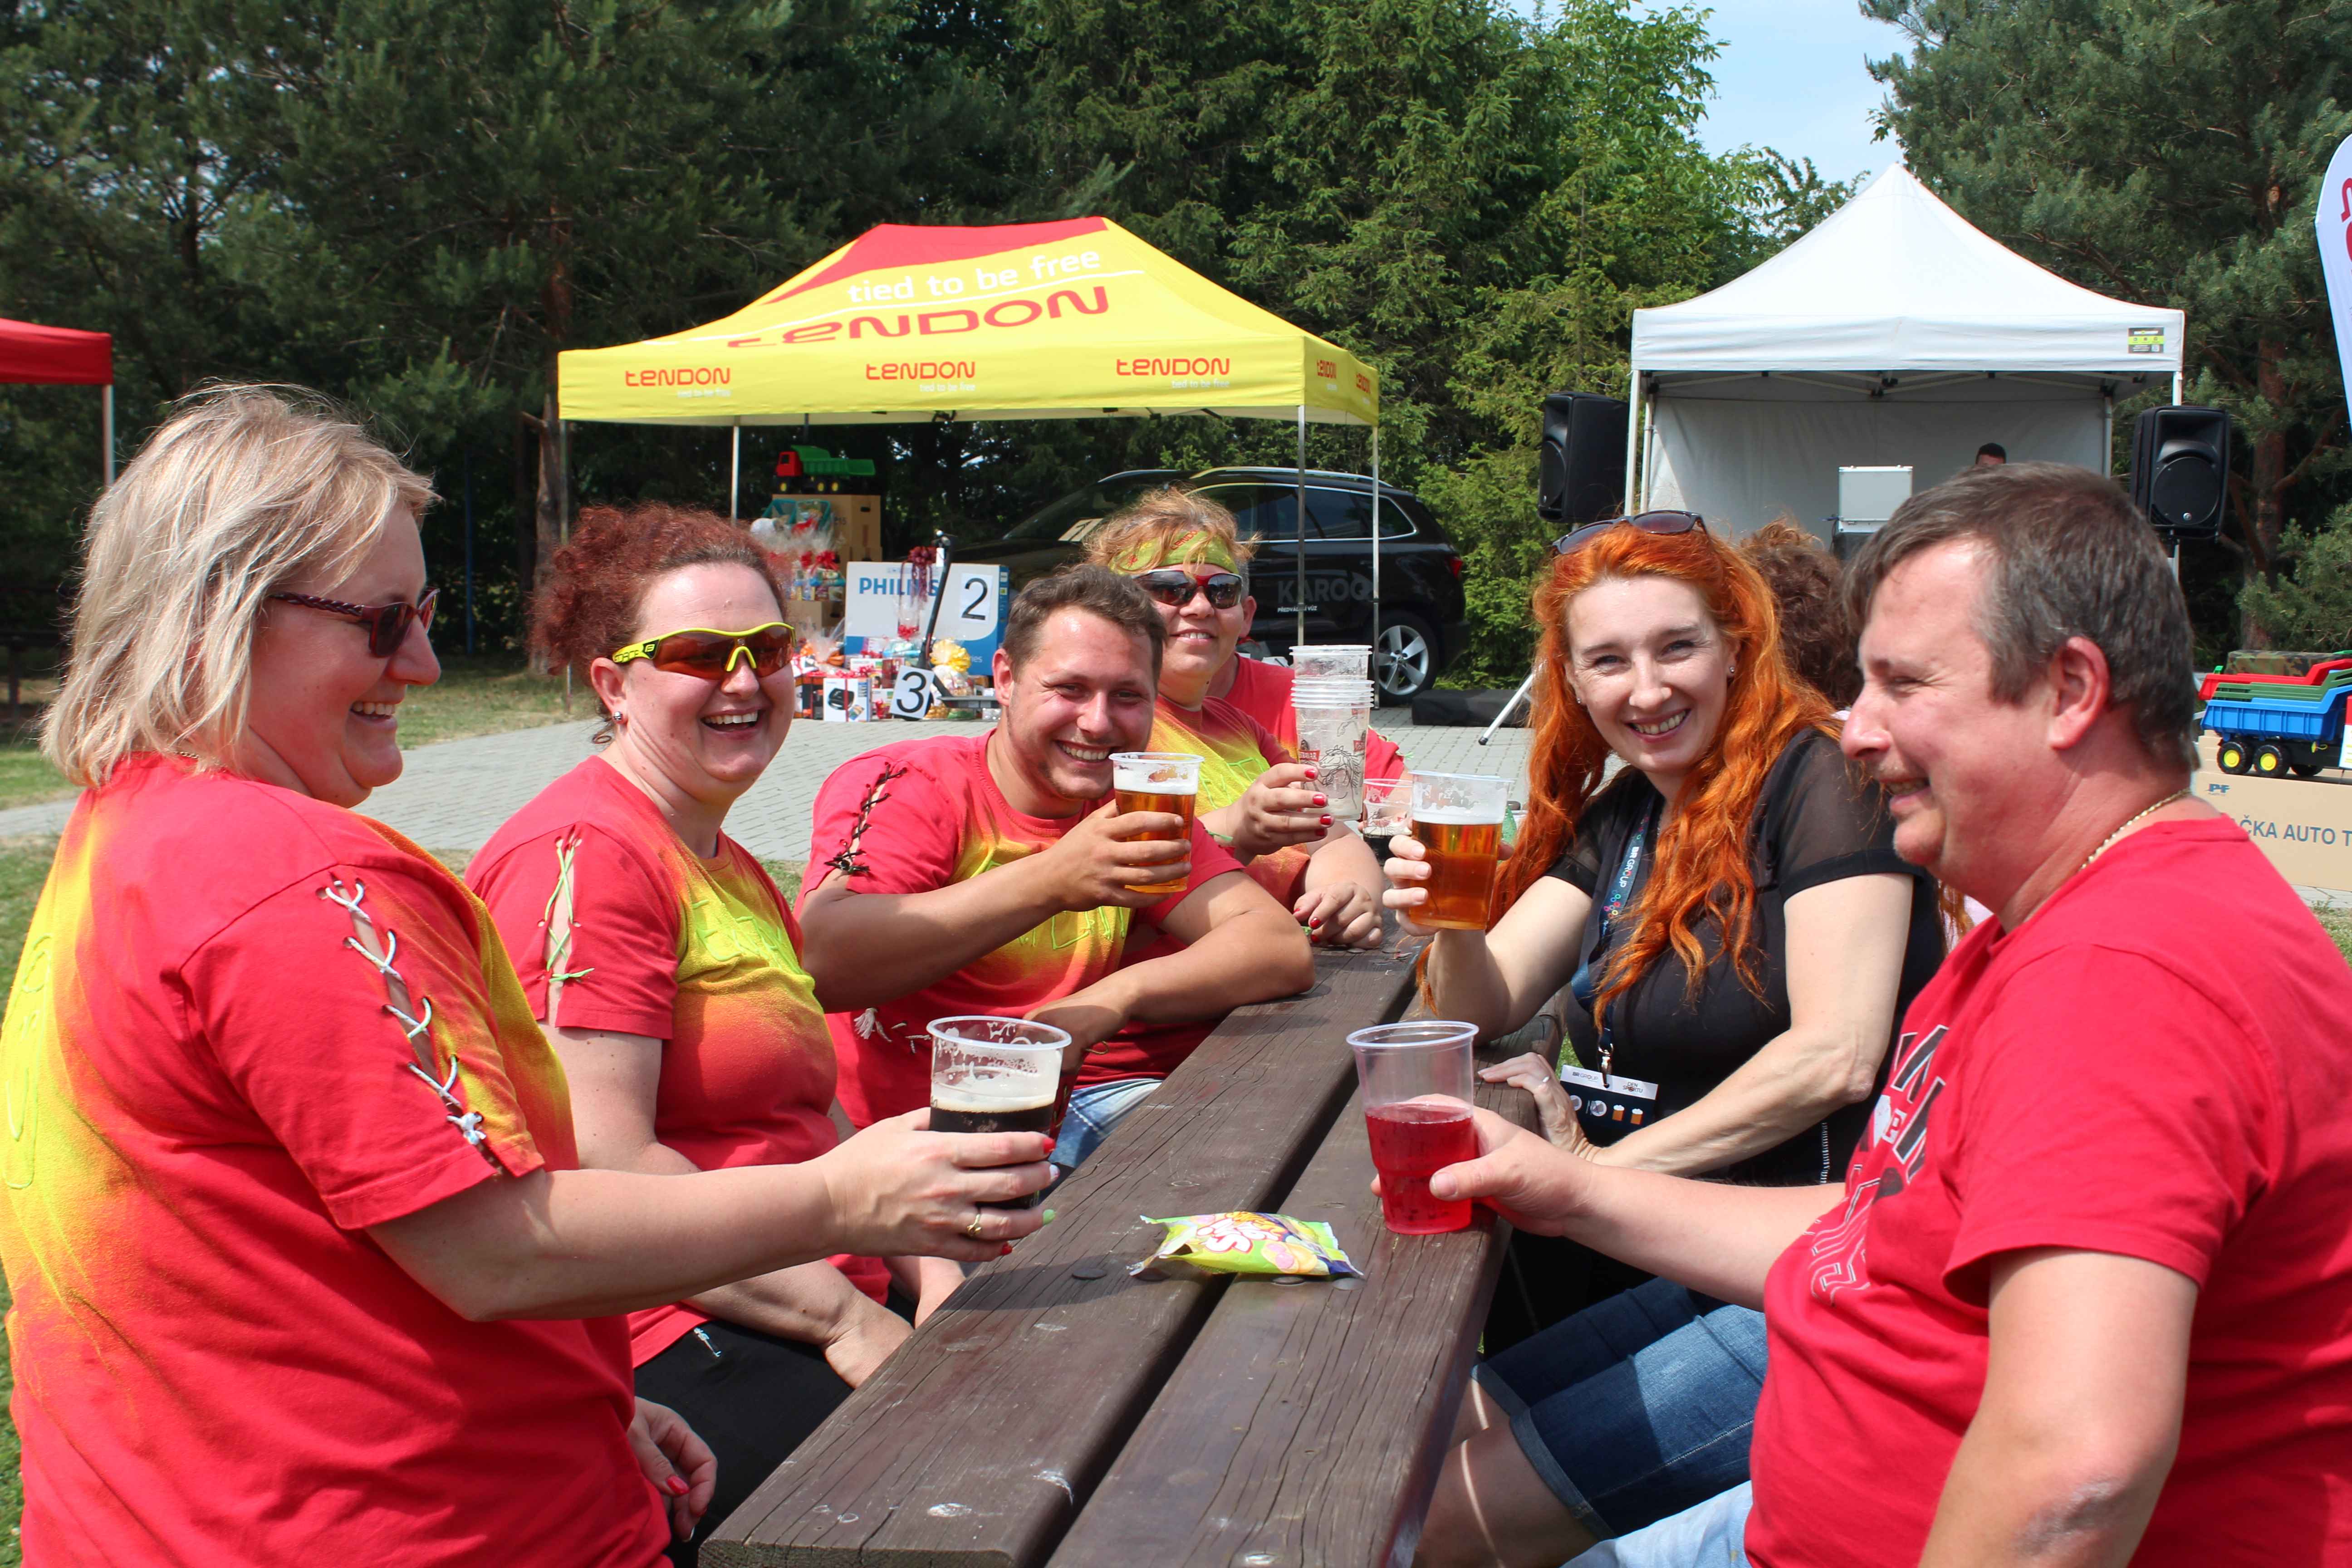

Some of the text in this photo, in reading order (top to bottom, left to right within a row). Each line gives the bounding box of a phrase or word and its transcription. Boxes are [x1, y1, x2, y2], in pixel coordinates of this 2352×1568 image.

[848, 250, 1100, 303] tied to be free
[961, 578, 988, 620] 2
[1278, 578, 1372, 604] KAROQ
[897, 671, 926, 713] 3
[2283, 824, 2336, 845] AUTO
[1619, 846, 1640, 888] BR GROUP
